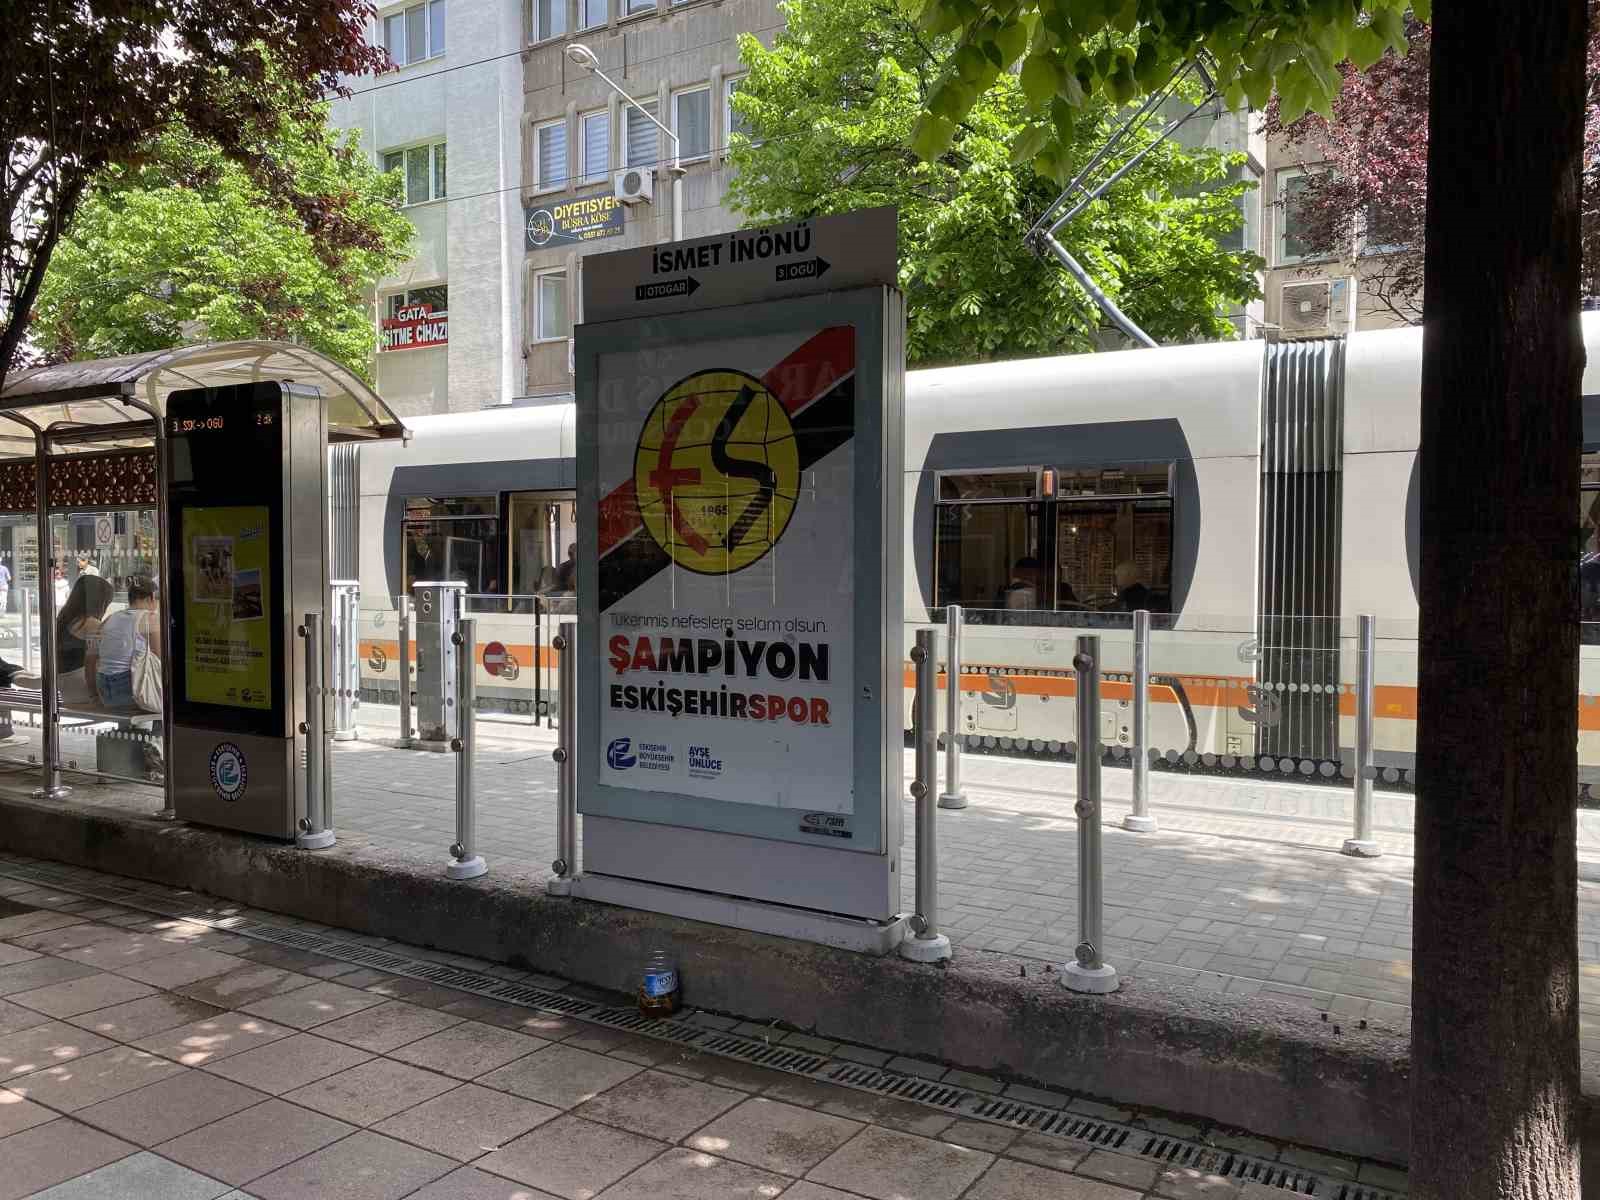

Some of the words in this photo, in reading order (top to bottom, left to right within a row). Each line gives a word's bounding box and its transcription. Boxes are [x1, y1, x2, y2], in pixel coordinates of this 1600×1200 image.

[653, 243, 722, 274] İSMET
[730, 222, 811, 263] İNÖNÜ
[398, 307, 427, 322] GATA
[672, 614, 733, 631] nefeslere
[737, 616, 781, 632] selam
[608, 628, 829, 681] ŞAMPİYON
[609, 680, 829, 724] ESKİŞEHİRSPOR
